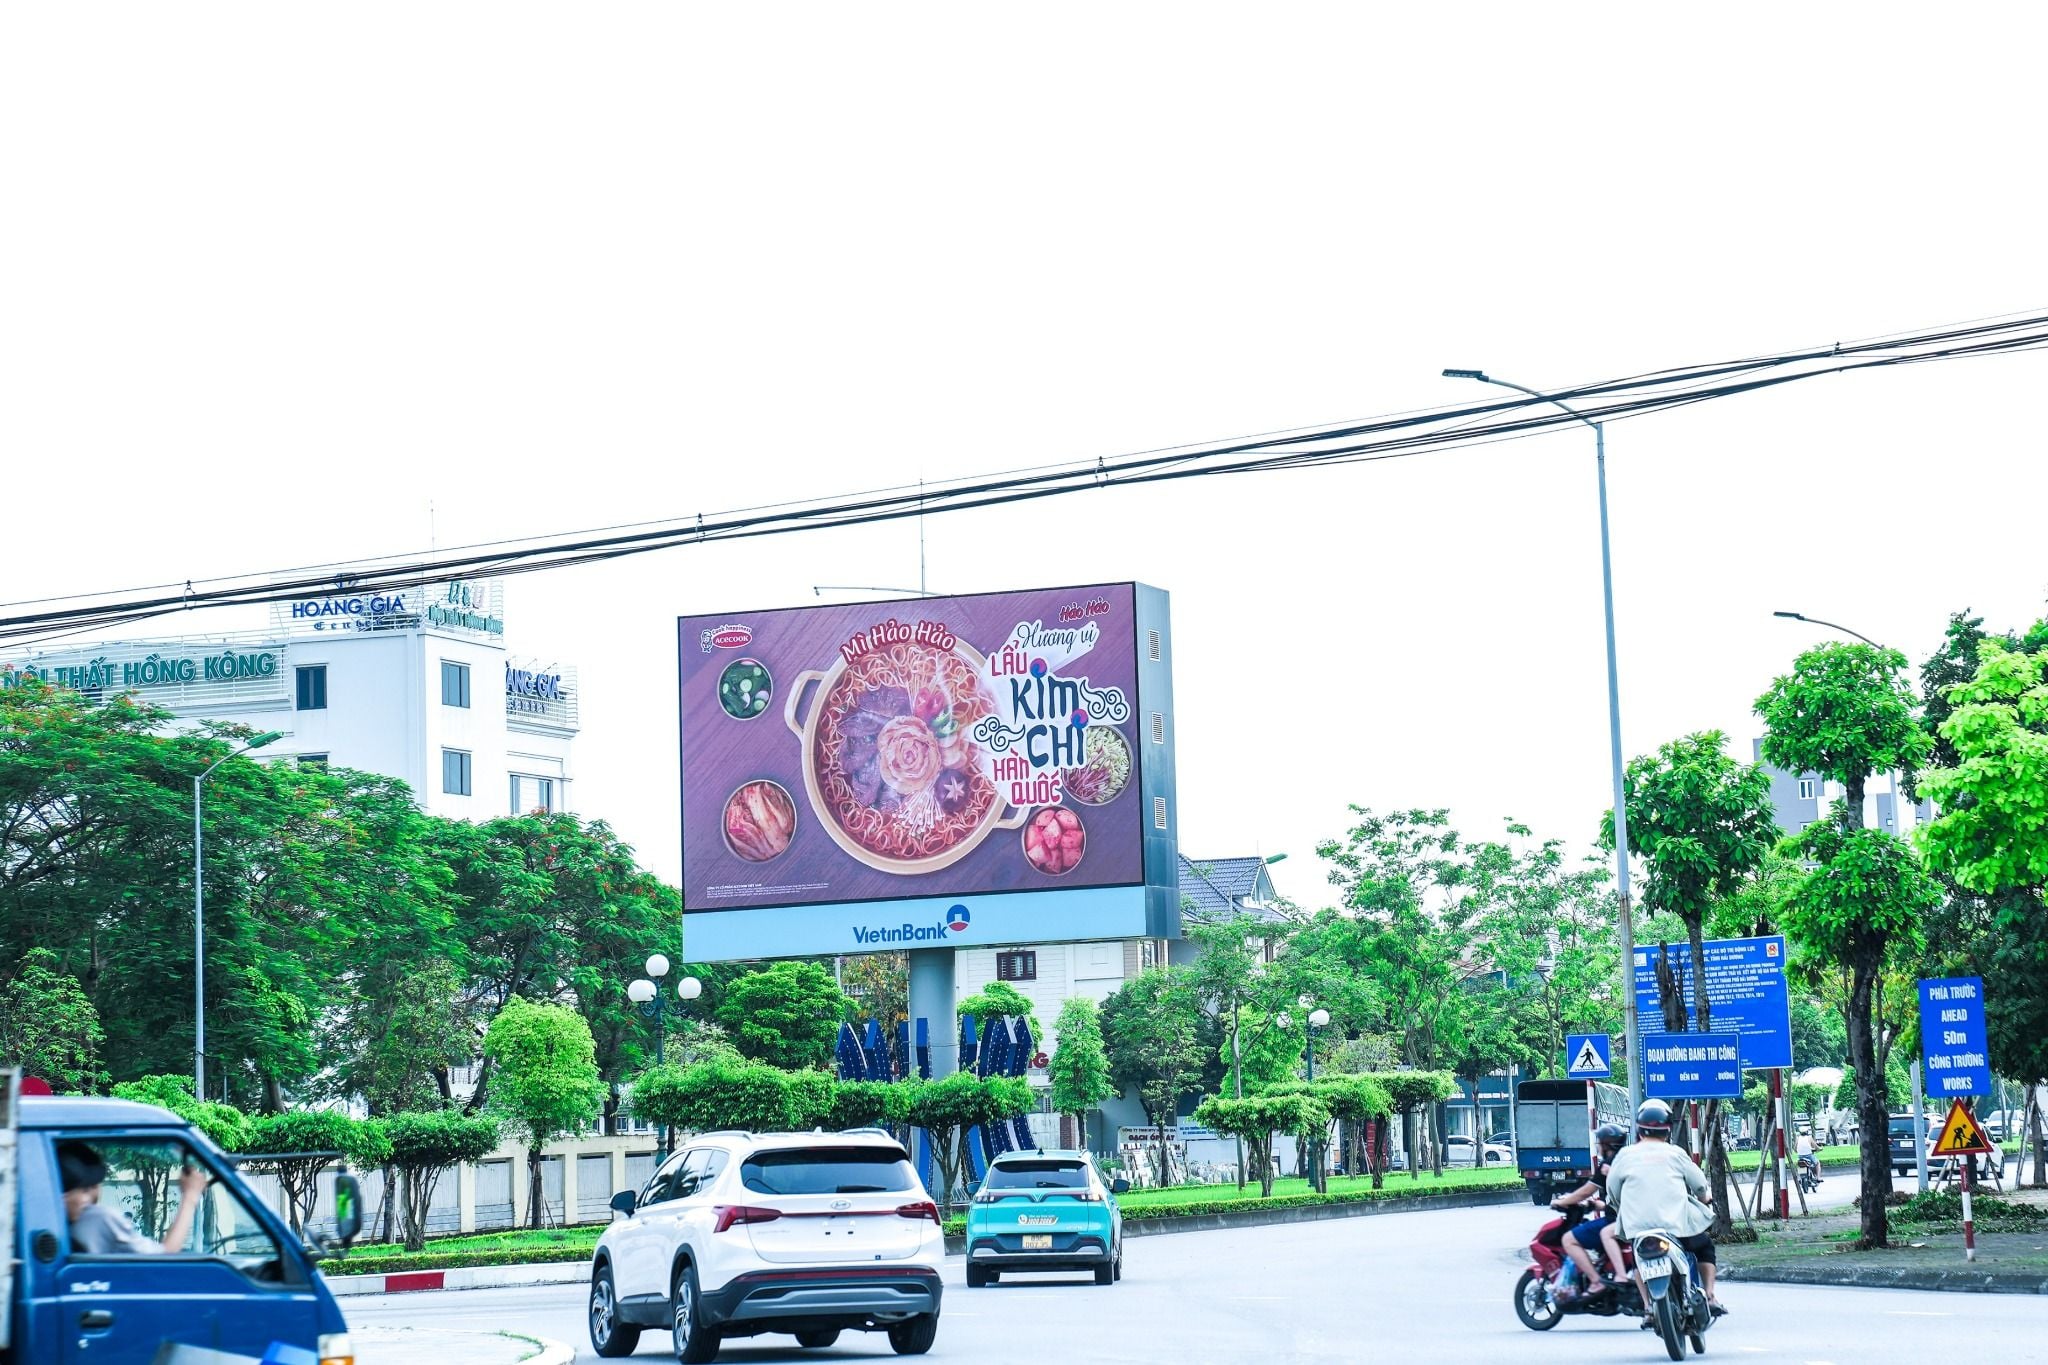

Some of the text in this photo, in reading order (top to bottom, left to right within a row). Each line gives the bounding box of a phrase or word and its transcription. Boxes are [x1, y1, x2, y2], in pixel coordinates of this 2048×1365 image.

[292, 596, 404, 618] HOÀNG GIA
[1059, 597, 1110, 621] Hảo Hảo
[841, 620, 955, 662] Mì Hảo Hảo
[1017, 623, 1098, 653] Hương vị
[54, 657, 116, 688] THẤT
[123, 653, 196, 685] HỒNG
[204, 650, 275, 680] KÔNG
[991, 640, 1027, 676] LẨU
[1011, 770, 1061, 804] QUỐC
[852, 922, 948, 943] VietinBank
[1929, 983, 1976, 1000] PHÍA TRƯỚC
[1941, 1009, 1968, 1022] AHEAD
[1944, 1031, 1967, 1045] 50m
[1647, 1043, 1736, 1065] ĐOẠN ĐƯỜNG ĐANG THI CÔNG
[1929, 1051, 1984, 1069] CÔNG TRƯỜNG
[1657, 1073, 1665, 1081] KM
[1690, 1073, 1699, 1081] KM
[1942, 1077, 1972, 1090] WORKS
